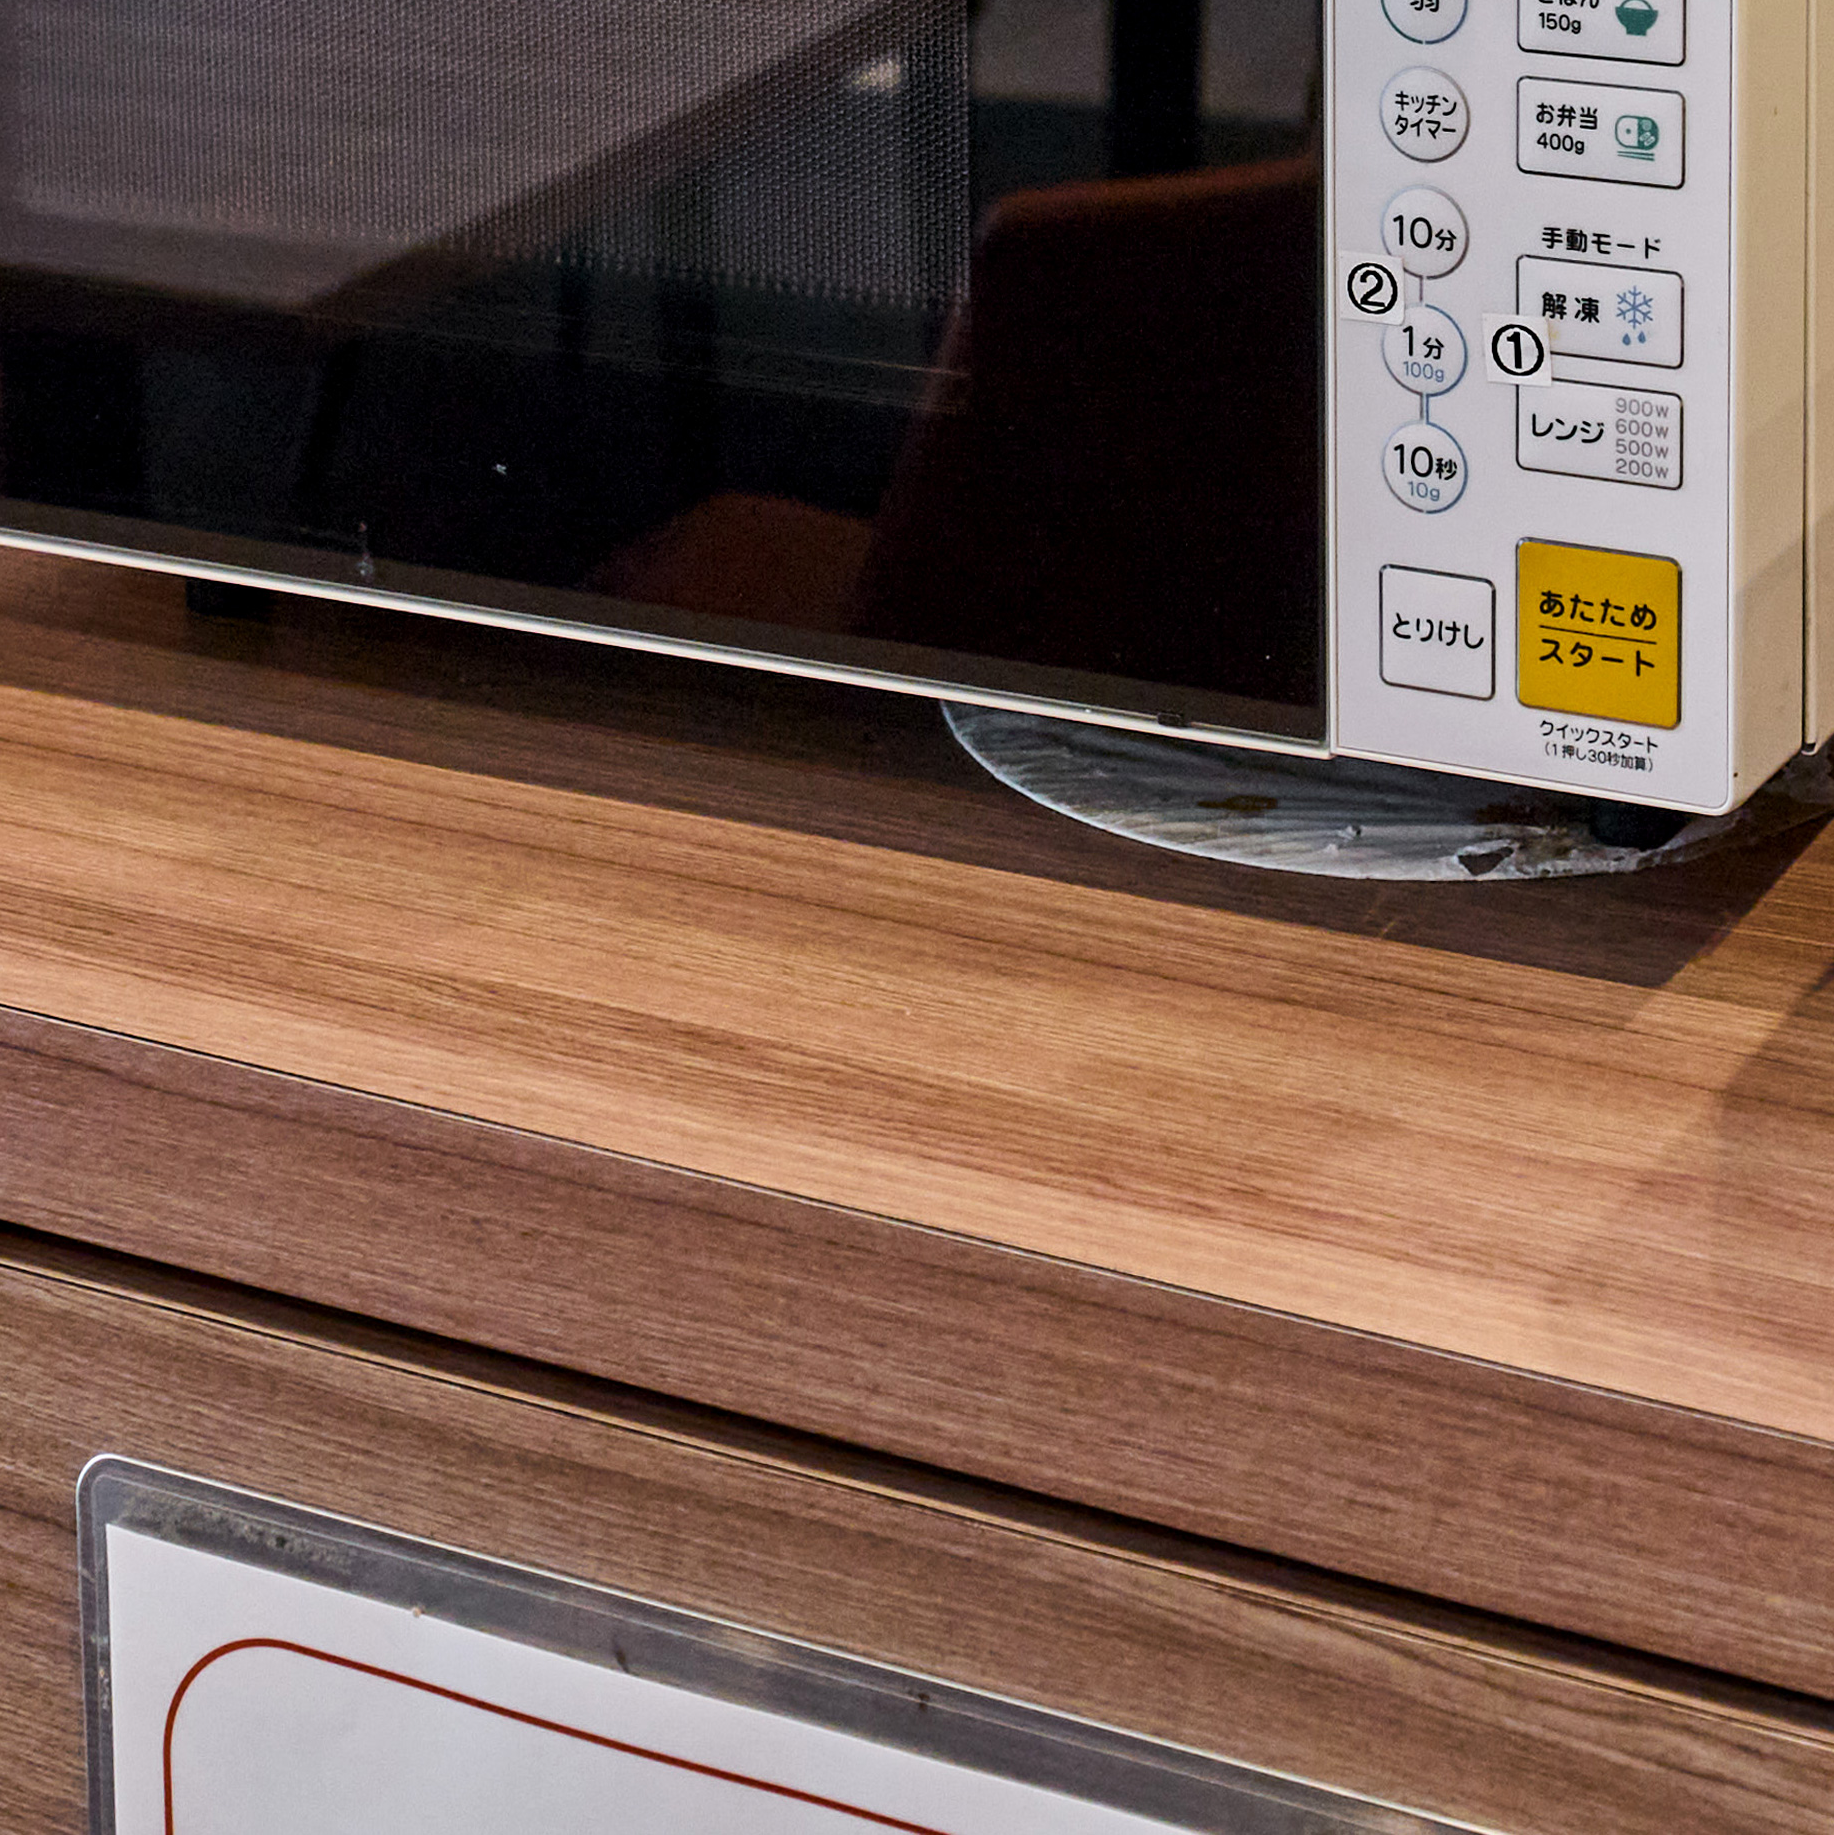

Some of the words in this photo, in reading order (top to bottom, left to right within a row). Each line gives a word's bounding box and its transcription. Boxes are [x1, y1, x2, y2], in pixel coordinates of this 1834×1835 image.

[1539, 12, 1581, 34] 150g
[1394, 90, 1457, 116] キッチン
[1536, 103, 1597, 130] お弁当
[1394, 116, 1457, 140] タイマー
[1537, 133, 1584, 155] 400g
[1541, 227, 1660, 258] 手動モード
[1403, 361, 1444, 384] 100g
[1532, 414, 1604, 443] レンジ
[1408, 478, 1442, 501] 10g
[1539, 590, 1656, 633] あたため
[1393, 613, 1484, 649] とりけし
[1539, 635, 1656, 677] スタート
[1540, 720, 1659, 751] クイックスタート
